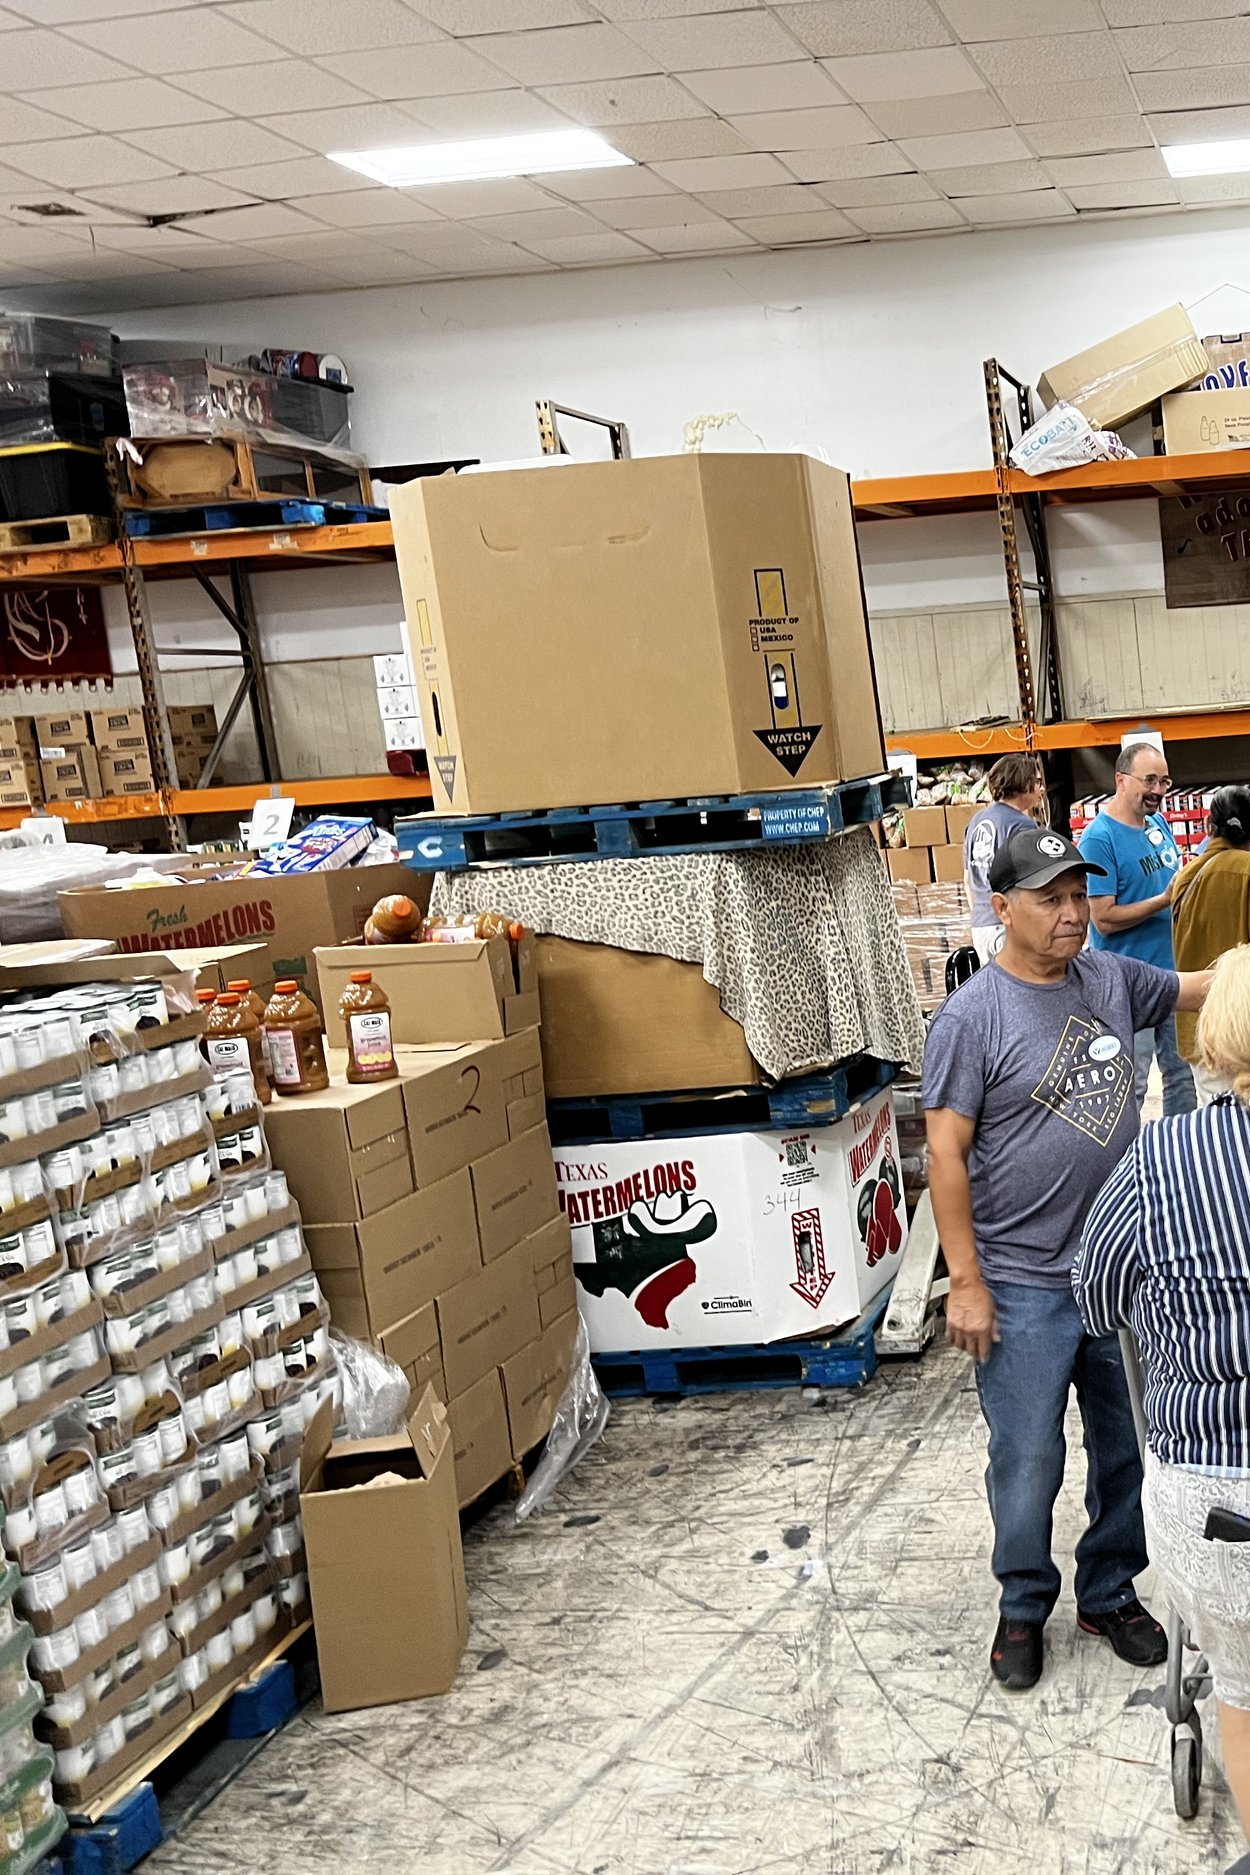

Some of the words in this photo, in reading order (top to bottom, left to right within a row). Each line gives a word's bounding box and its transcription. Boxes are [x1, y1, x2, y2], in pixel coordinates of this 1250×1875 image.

[749, 618, 786, 626] PRODUCT
[761, 634, 794, 642] MEXICO
[767, 732, 811, 744] WATCH
[776, 744, 806, 756] STEP
[763, 808, 797, 822] PROPERTY
[797, 807, 806, 818] OF
[807, 806, 825, 818] CHEP
[263, 814, 280, 836] 2
[146, 904, 188, 932] Fresh
[1064, 1066, 1116, 1093] AERO
[460, 1065, 481, 1114] 2
[558, 1160, 697, 1225] ATERMELONS
[763, 1187, 800, 1216] 344
[711, 1298, 752, 1310] ClimaBin
